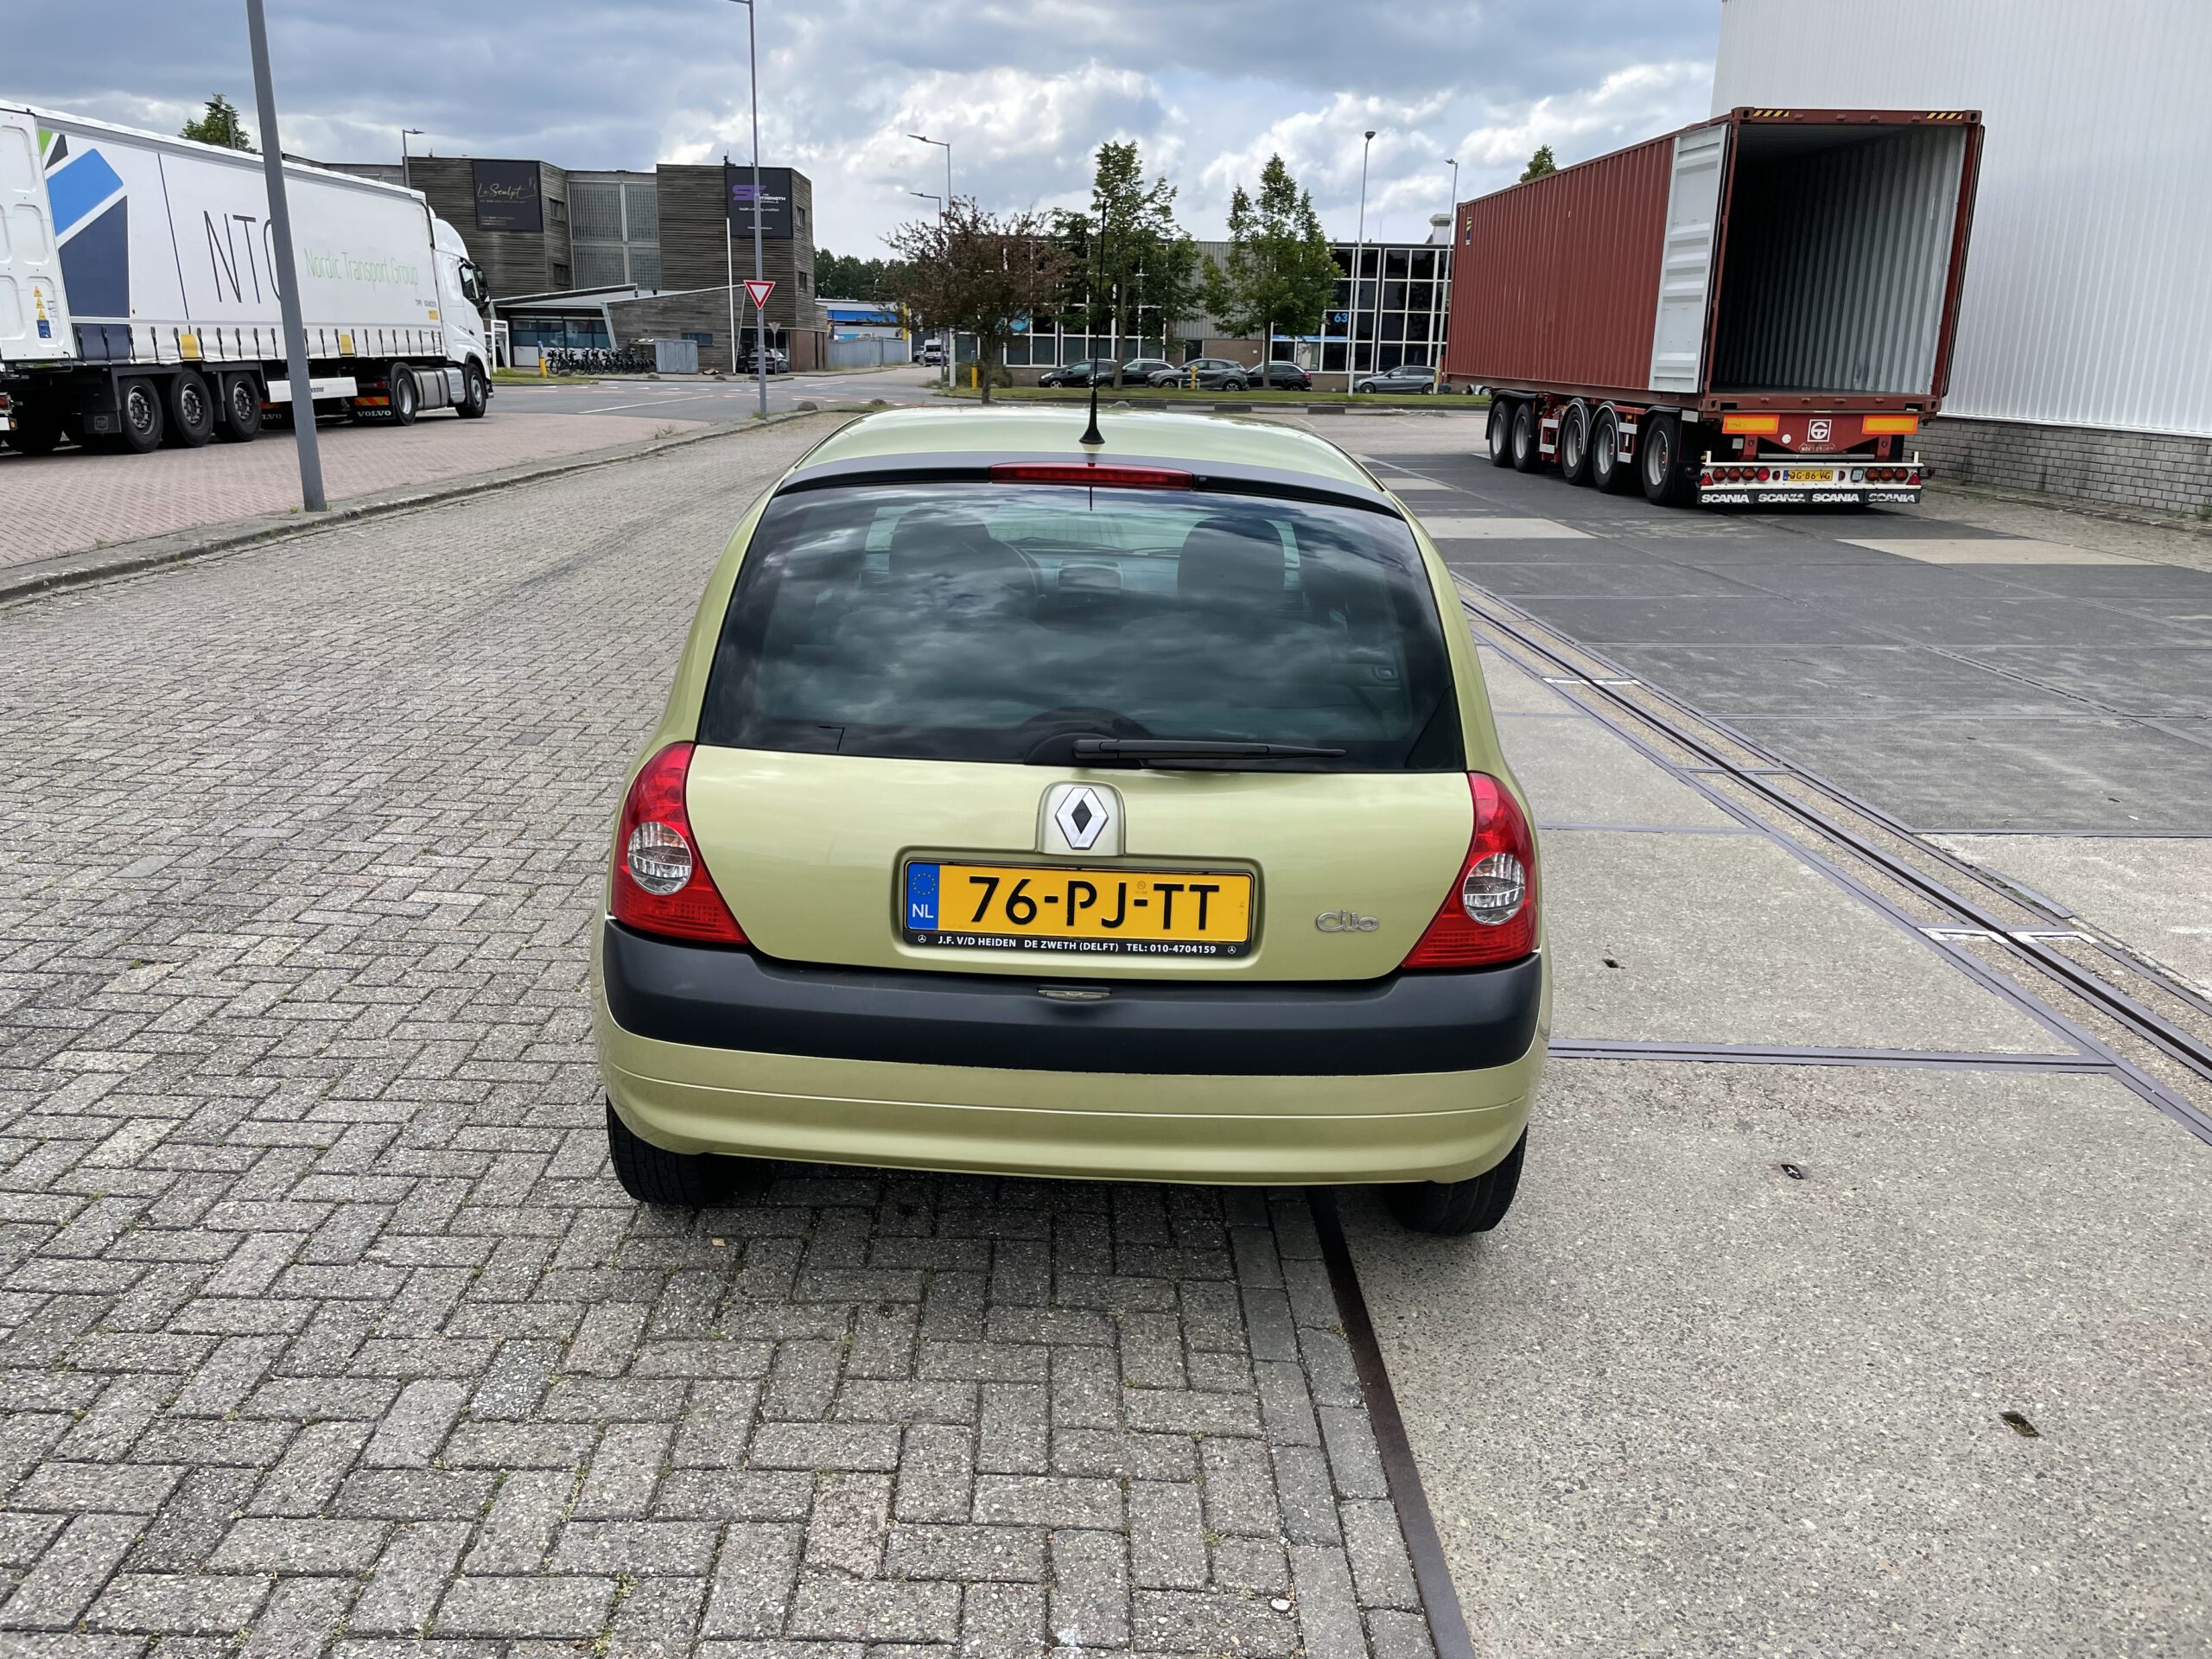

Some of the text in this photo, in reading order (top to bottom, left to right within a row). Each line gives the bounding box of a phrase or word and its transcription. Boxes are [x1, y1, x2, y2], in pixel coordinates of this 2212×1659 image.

[489, 183, 524, 200] Sculpt
[304, 248, 419, 294] Nordic Transport Group
[1334, 313, 1348, 323] 63
[1700, 493, 1750, 503] SCANIA
[1812, 493, 1859, 502] SCANIA
[1867, 493, 1916, 503] SCANIA
[912, 903, 934, 918] NL
[969, 875, 1219, 931] 76-PJ-TT
[1316, 909, 1379, 932] Clio
[938, 936, 1217, 954] J.F. V/D HEIDEN DE ZWETH (DELFT) TEL: 010-4704159
